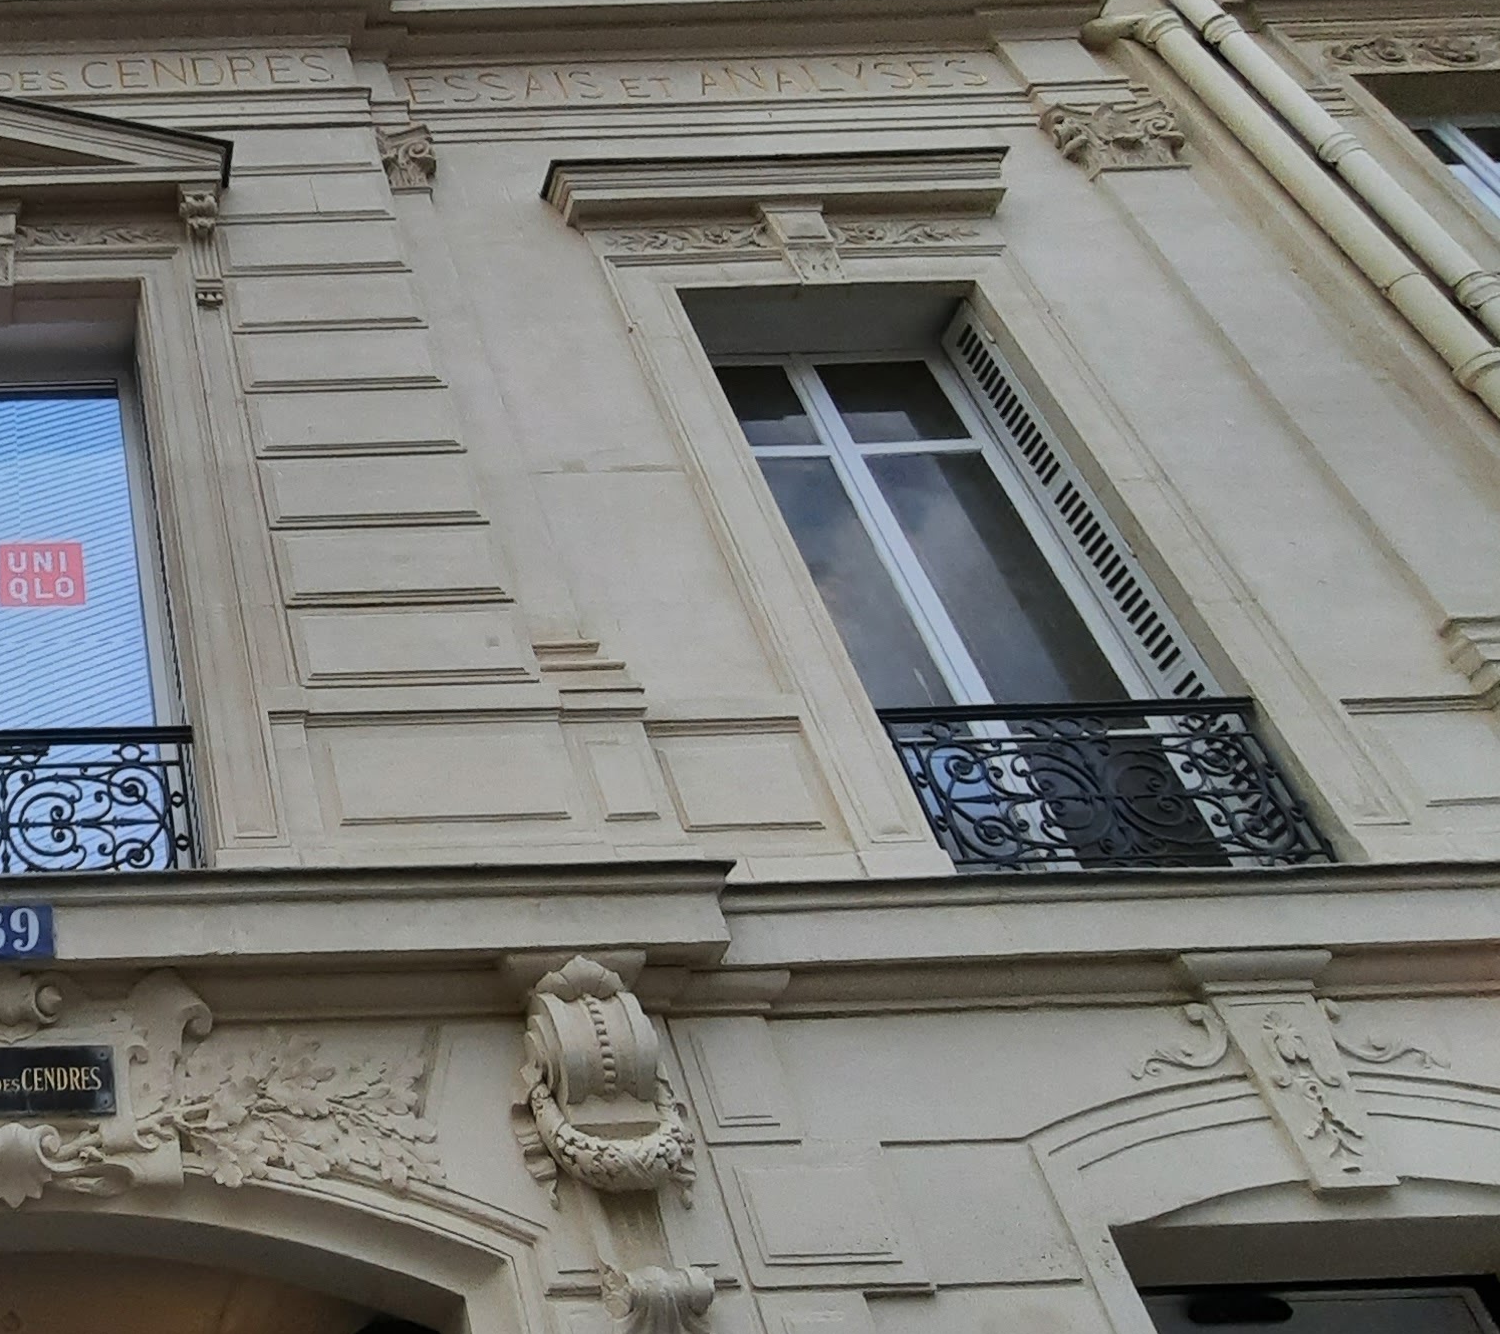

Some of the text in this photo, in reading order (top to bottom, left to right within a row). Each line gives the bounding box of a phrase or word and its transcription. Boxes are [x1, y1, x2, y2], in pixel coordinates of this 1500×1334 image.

[80, 54, 334, 89] CENDRES
[404, 60, 988, 104] ESSAIS ET ANALYSES
[7, 551, 67, 573] UNI
[8, 576, 75, 603] QLO
[21, 1066, 102, 1092] CENDRES
